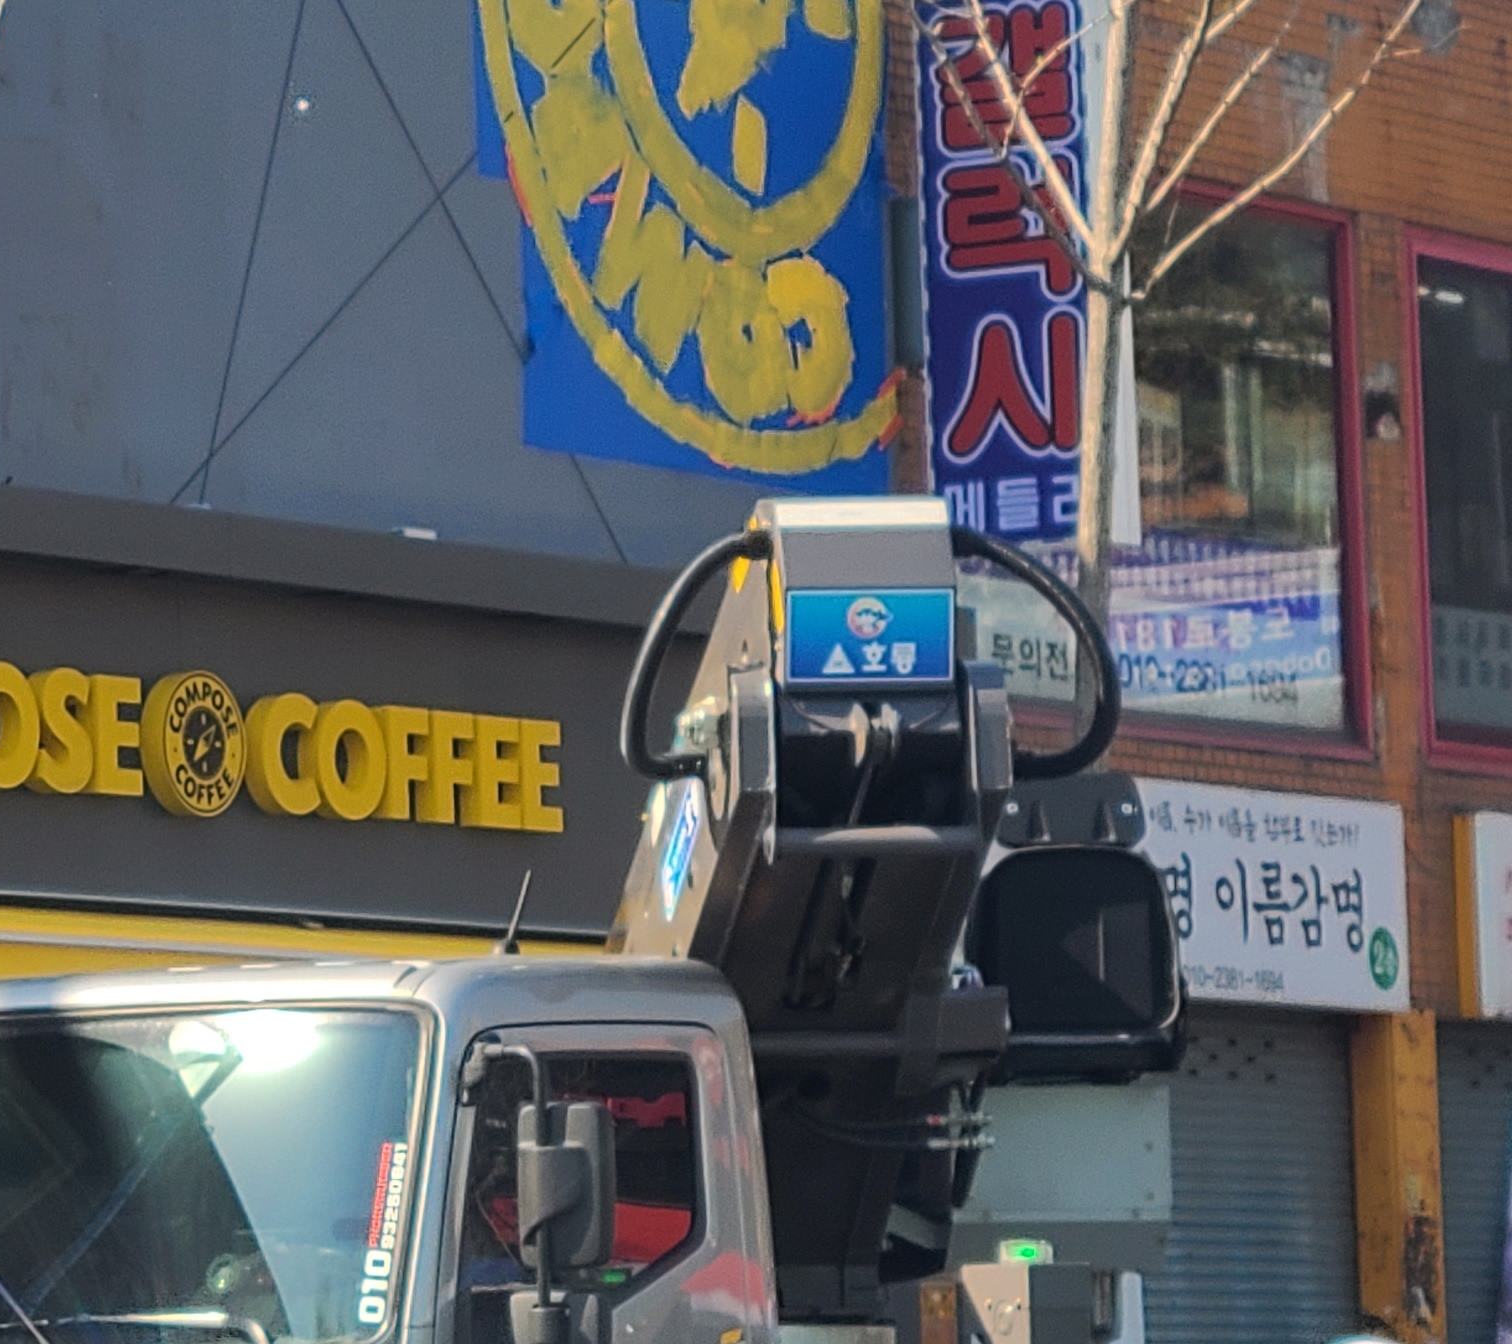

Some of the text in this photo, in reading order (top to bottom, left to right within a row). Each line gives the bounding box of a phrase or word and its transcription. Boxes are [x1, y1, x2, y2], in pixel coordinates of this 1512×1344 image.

[170, 681, 238, 739] COMPOSE
[176, 764, 235, 805] COFFEE
[245, 692, 563, 833] COFFEE
[1215, 858, 1364, 954] 이름감명
[358, 1250, 392, 1324] 010
